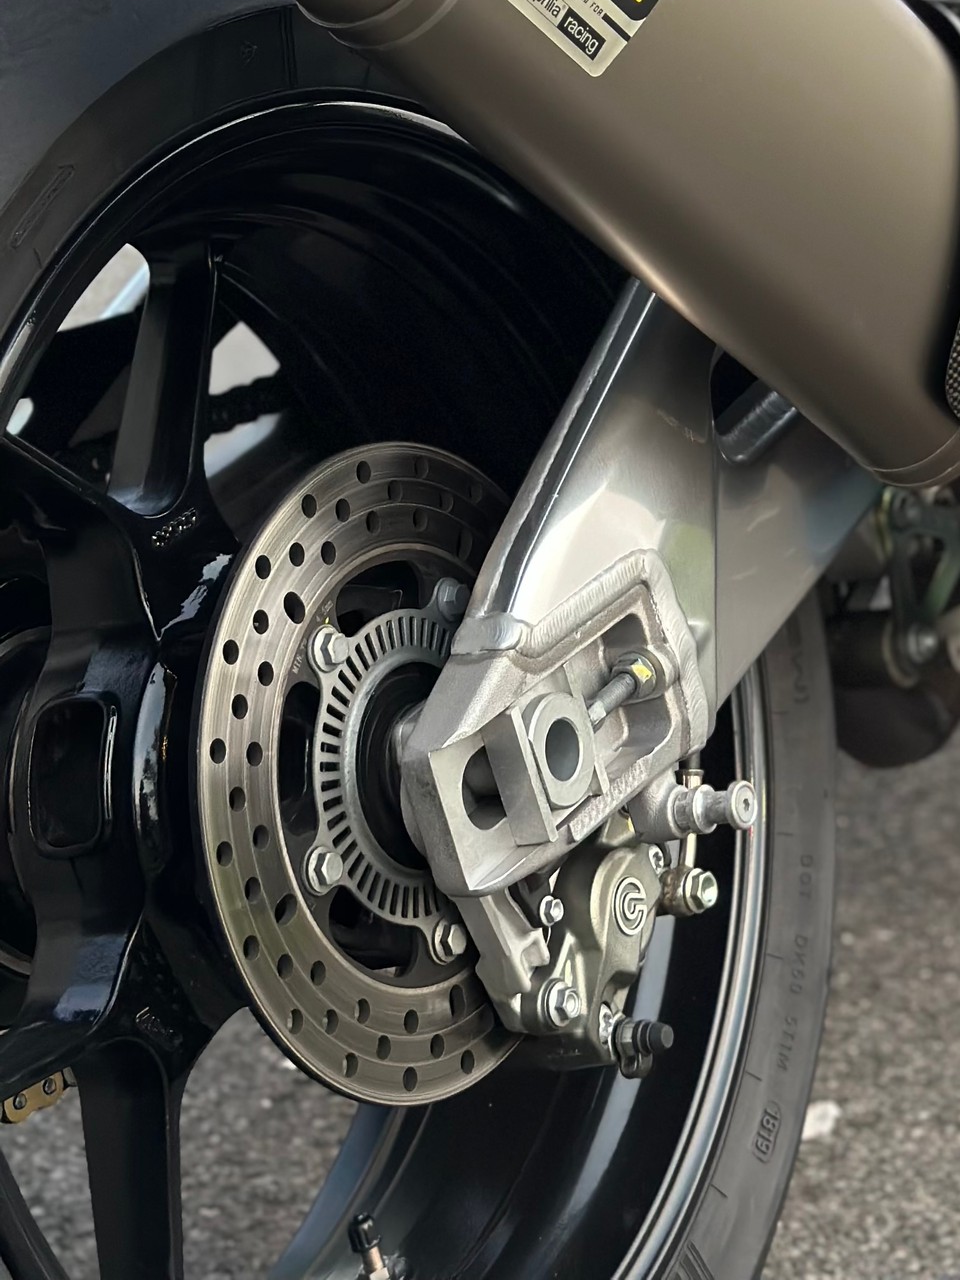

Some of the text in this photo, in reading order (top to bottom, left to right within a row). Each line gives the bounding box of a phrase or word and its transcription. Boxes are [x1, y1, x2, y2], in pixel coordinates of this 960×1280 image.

[590, 1, 604, 18] FOR
[563, 16, 599, 55] racing
[755, 1108, 779, 1155] 1819
